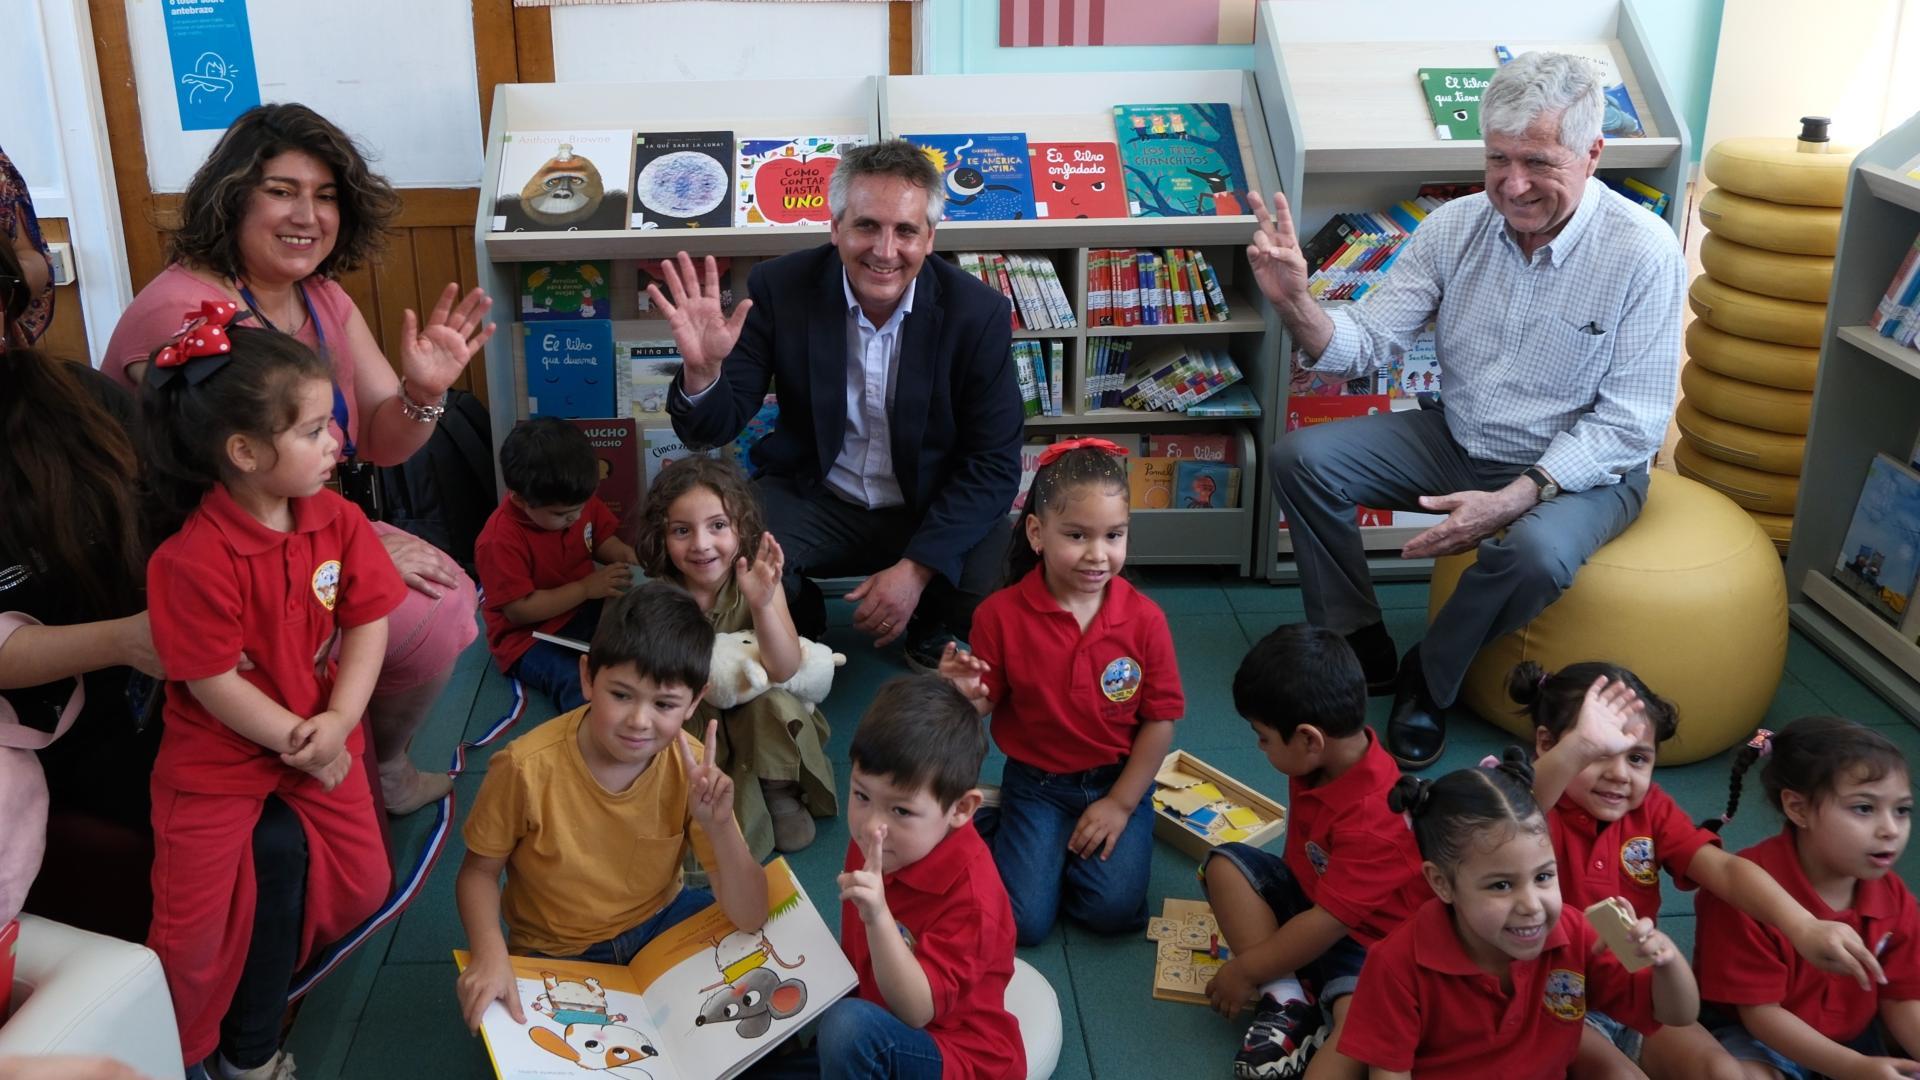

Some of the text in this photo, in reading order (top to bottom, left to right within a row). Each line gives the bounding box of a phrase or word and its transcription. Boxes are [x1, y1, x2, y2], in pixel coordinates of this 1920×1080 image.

[171, 6, 214, 15] antebrazo
[1445, 76, 1490, 89] El libro
[1434, 91, 1481, 107] que tiene
[519, 134, 611, 145] Anthony Browne
[1046, 148, 1104, 163] El libro
[1143, 146, 1197, 155] LOS TRES
[784, 168, 819, 177] COMO
[981, 164, 1016, 172] LATINA
[1048, 162, 1106, 180] enfadado
[780, 177, 825, 186] CONTAR
[785, 186, 821, 195] HASTA
[783, 194, 824, 209] UNO
[543, 334, 593, 352] El libro
[542, 354, 598, 370] que duerme
[584, 428, 628, 438] AUCHO
[652, 443, 677, 458] Cinco
[1193, 445, 1223, 460] libro
[1144, 461, 1175, 476] Pomel
